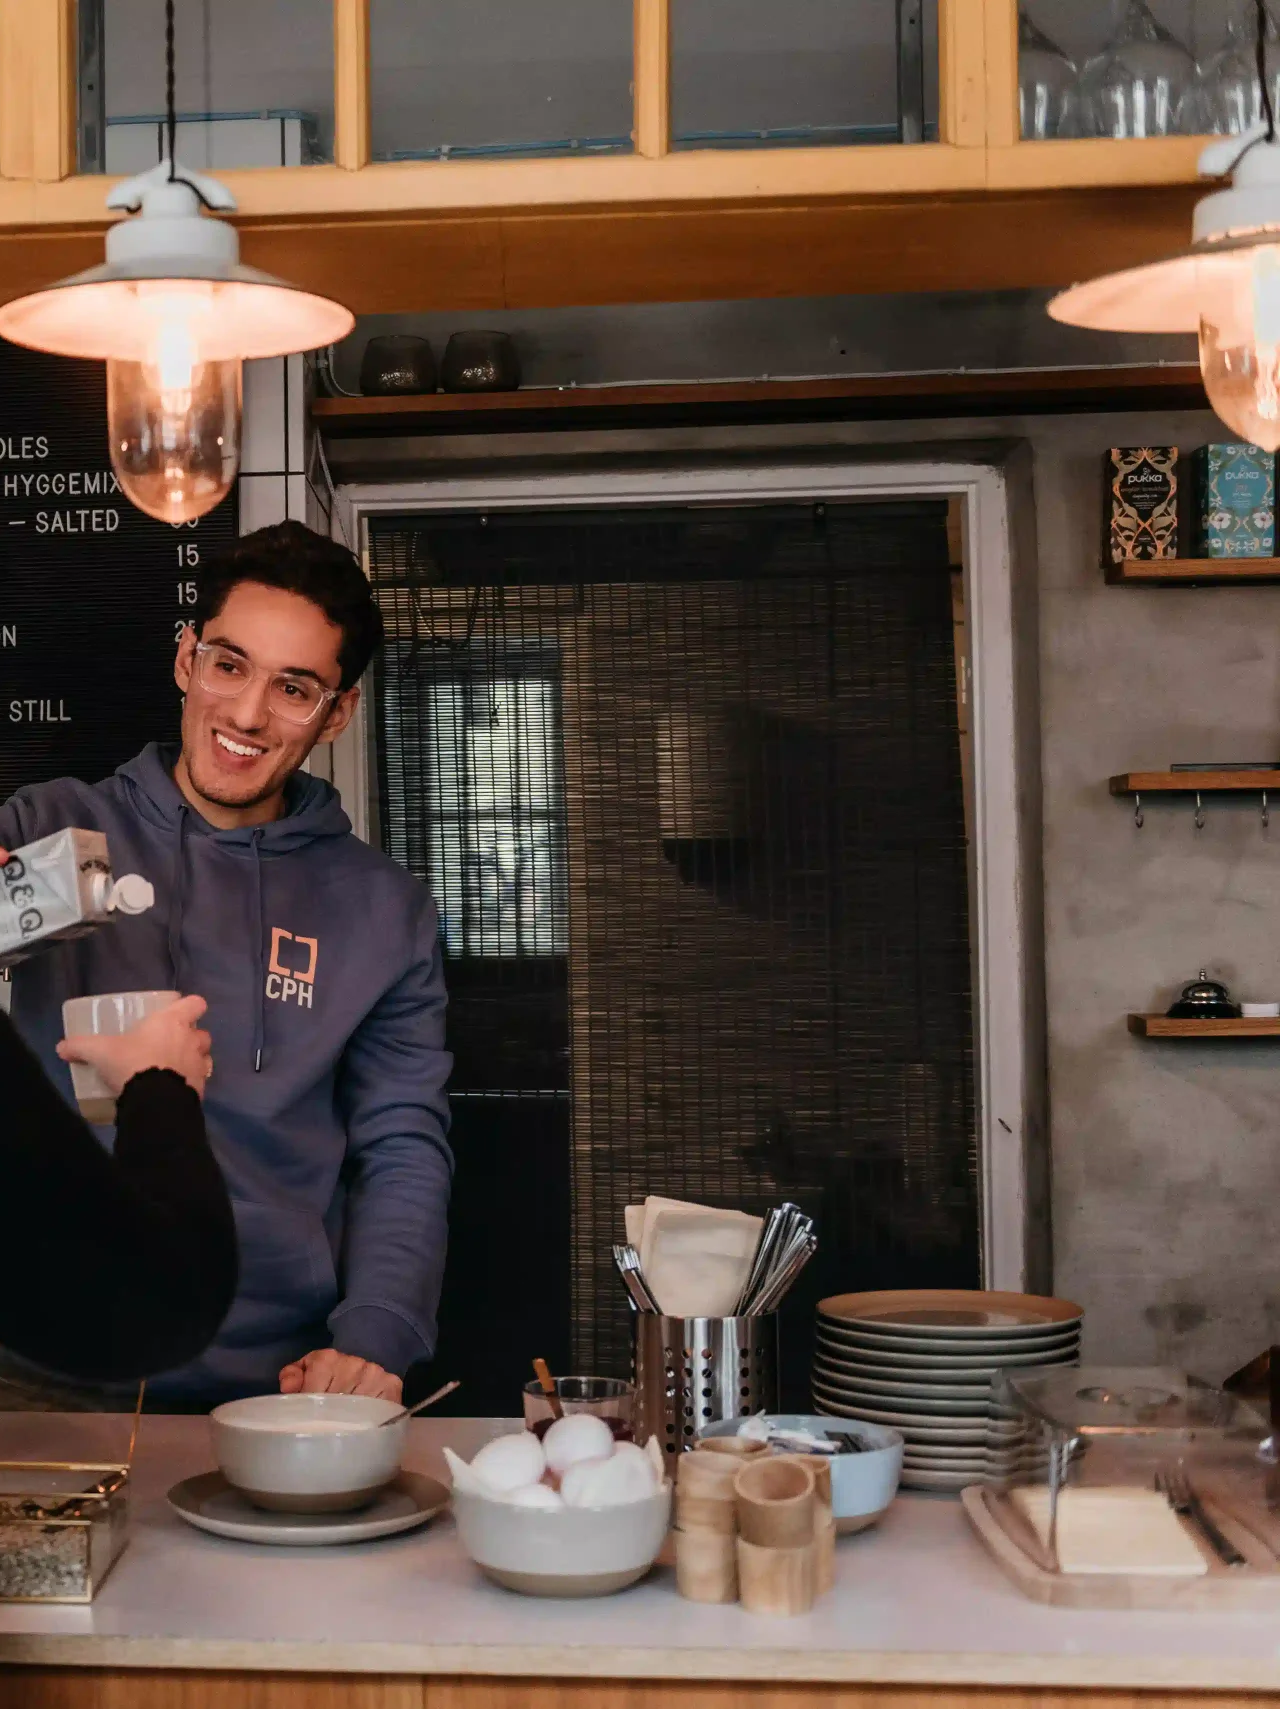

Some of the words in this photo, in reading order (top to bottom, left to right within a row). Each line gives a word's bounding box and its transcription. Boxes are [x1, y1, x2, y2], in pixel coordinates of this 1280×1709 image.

[4, 471, 123, 498] HYGGEMIX
[35, 509, 120, 534] SALTED
[176, 544, 200, 567] 15
[176, 582, 198, 605] 15
[174, 619, 196, 643] 2
[9, 699, 72, 723] STILL
[265, 973, 313, 1009] CPH
